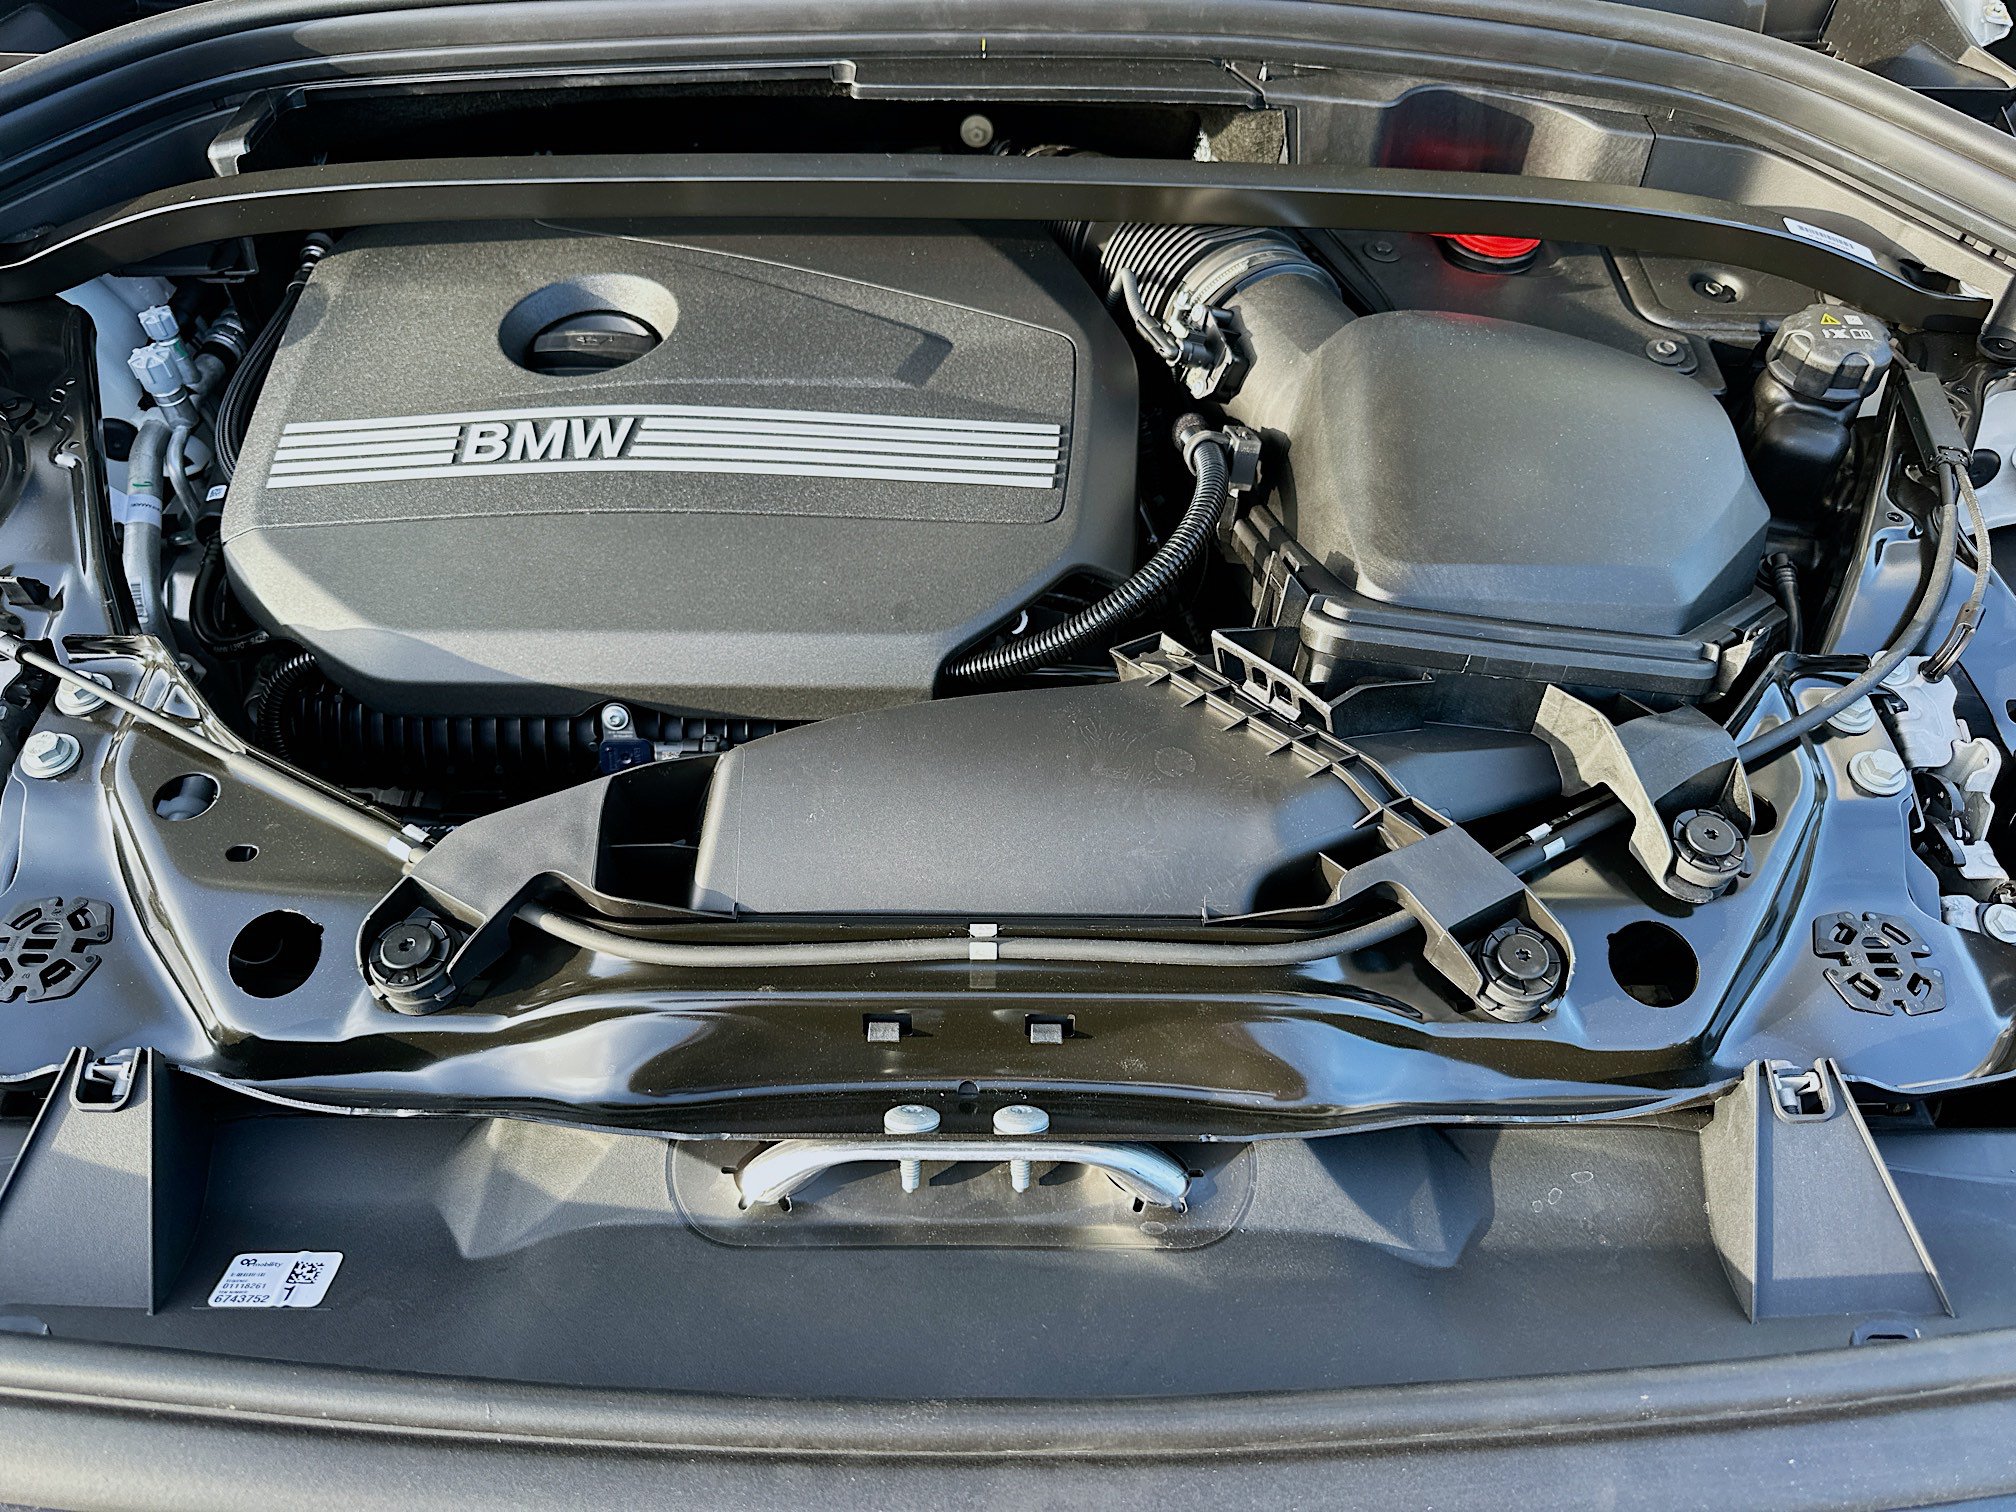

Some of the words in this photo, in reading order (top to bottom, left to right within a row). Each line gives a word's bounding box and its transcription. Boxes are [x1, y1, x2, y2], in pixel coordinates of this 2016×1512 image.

[461, 417, 635, 463] BMW
[214, 1294, 270, 1303] 6743752
[284, 1285, 296, 1301] 1
